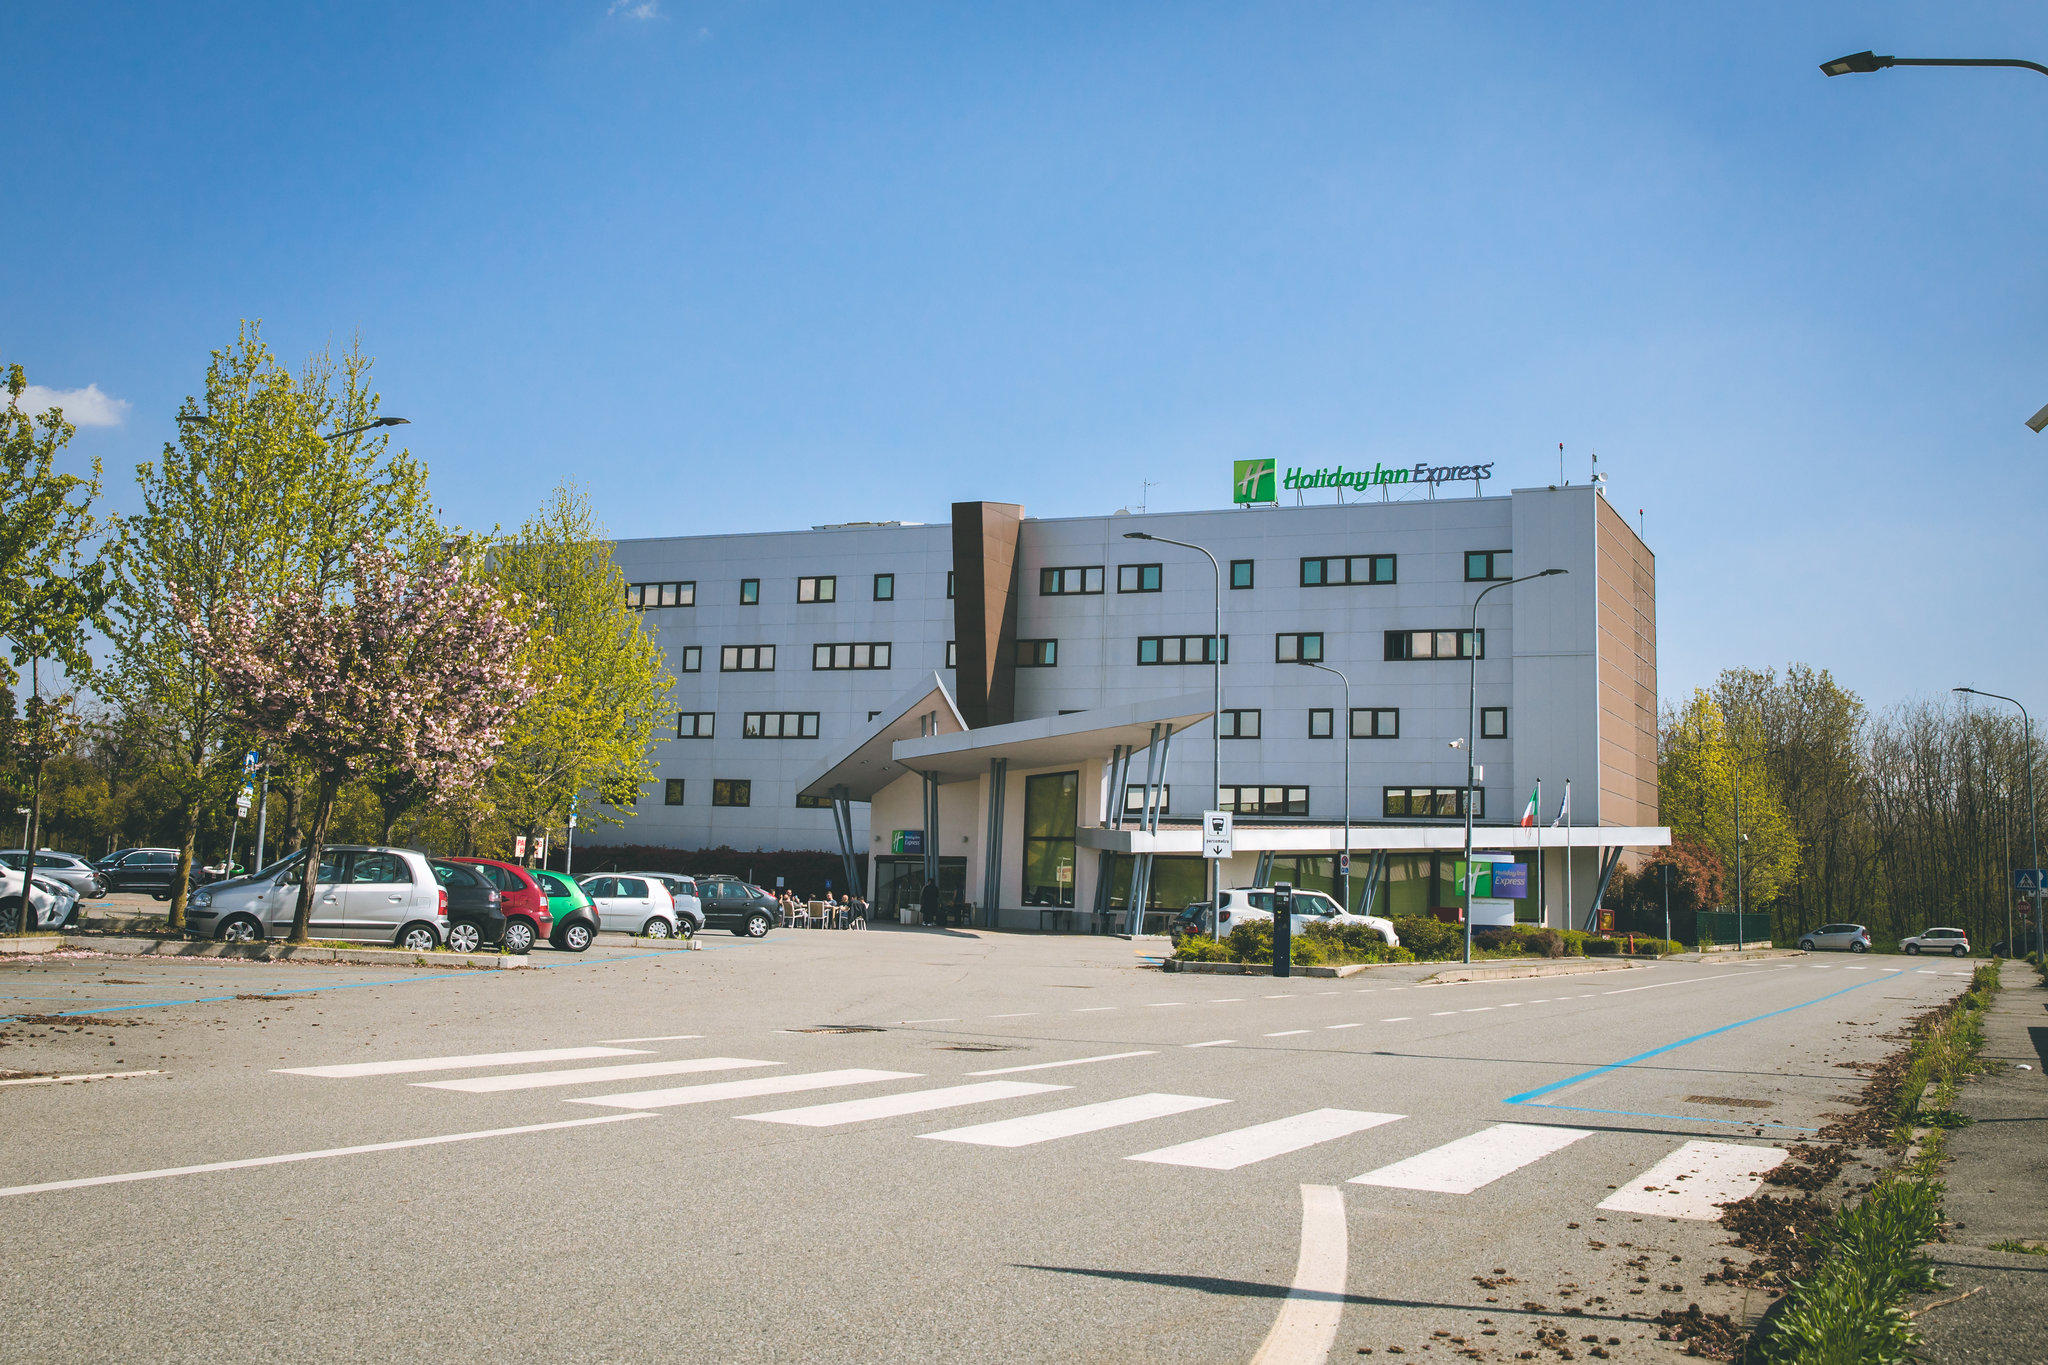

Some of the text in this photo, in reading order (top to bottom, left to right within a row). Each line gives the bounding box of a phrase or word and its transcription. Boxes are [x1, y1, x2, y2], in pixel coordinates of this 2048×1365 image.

[1283, 461, 1494, 492] Holiday Inn Express
[1495, 876, 1526, 886] Express
